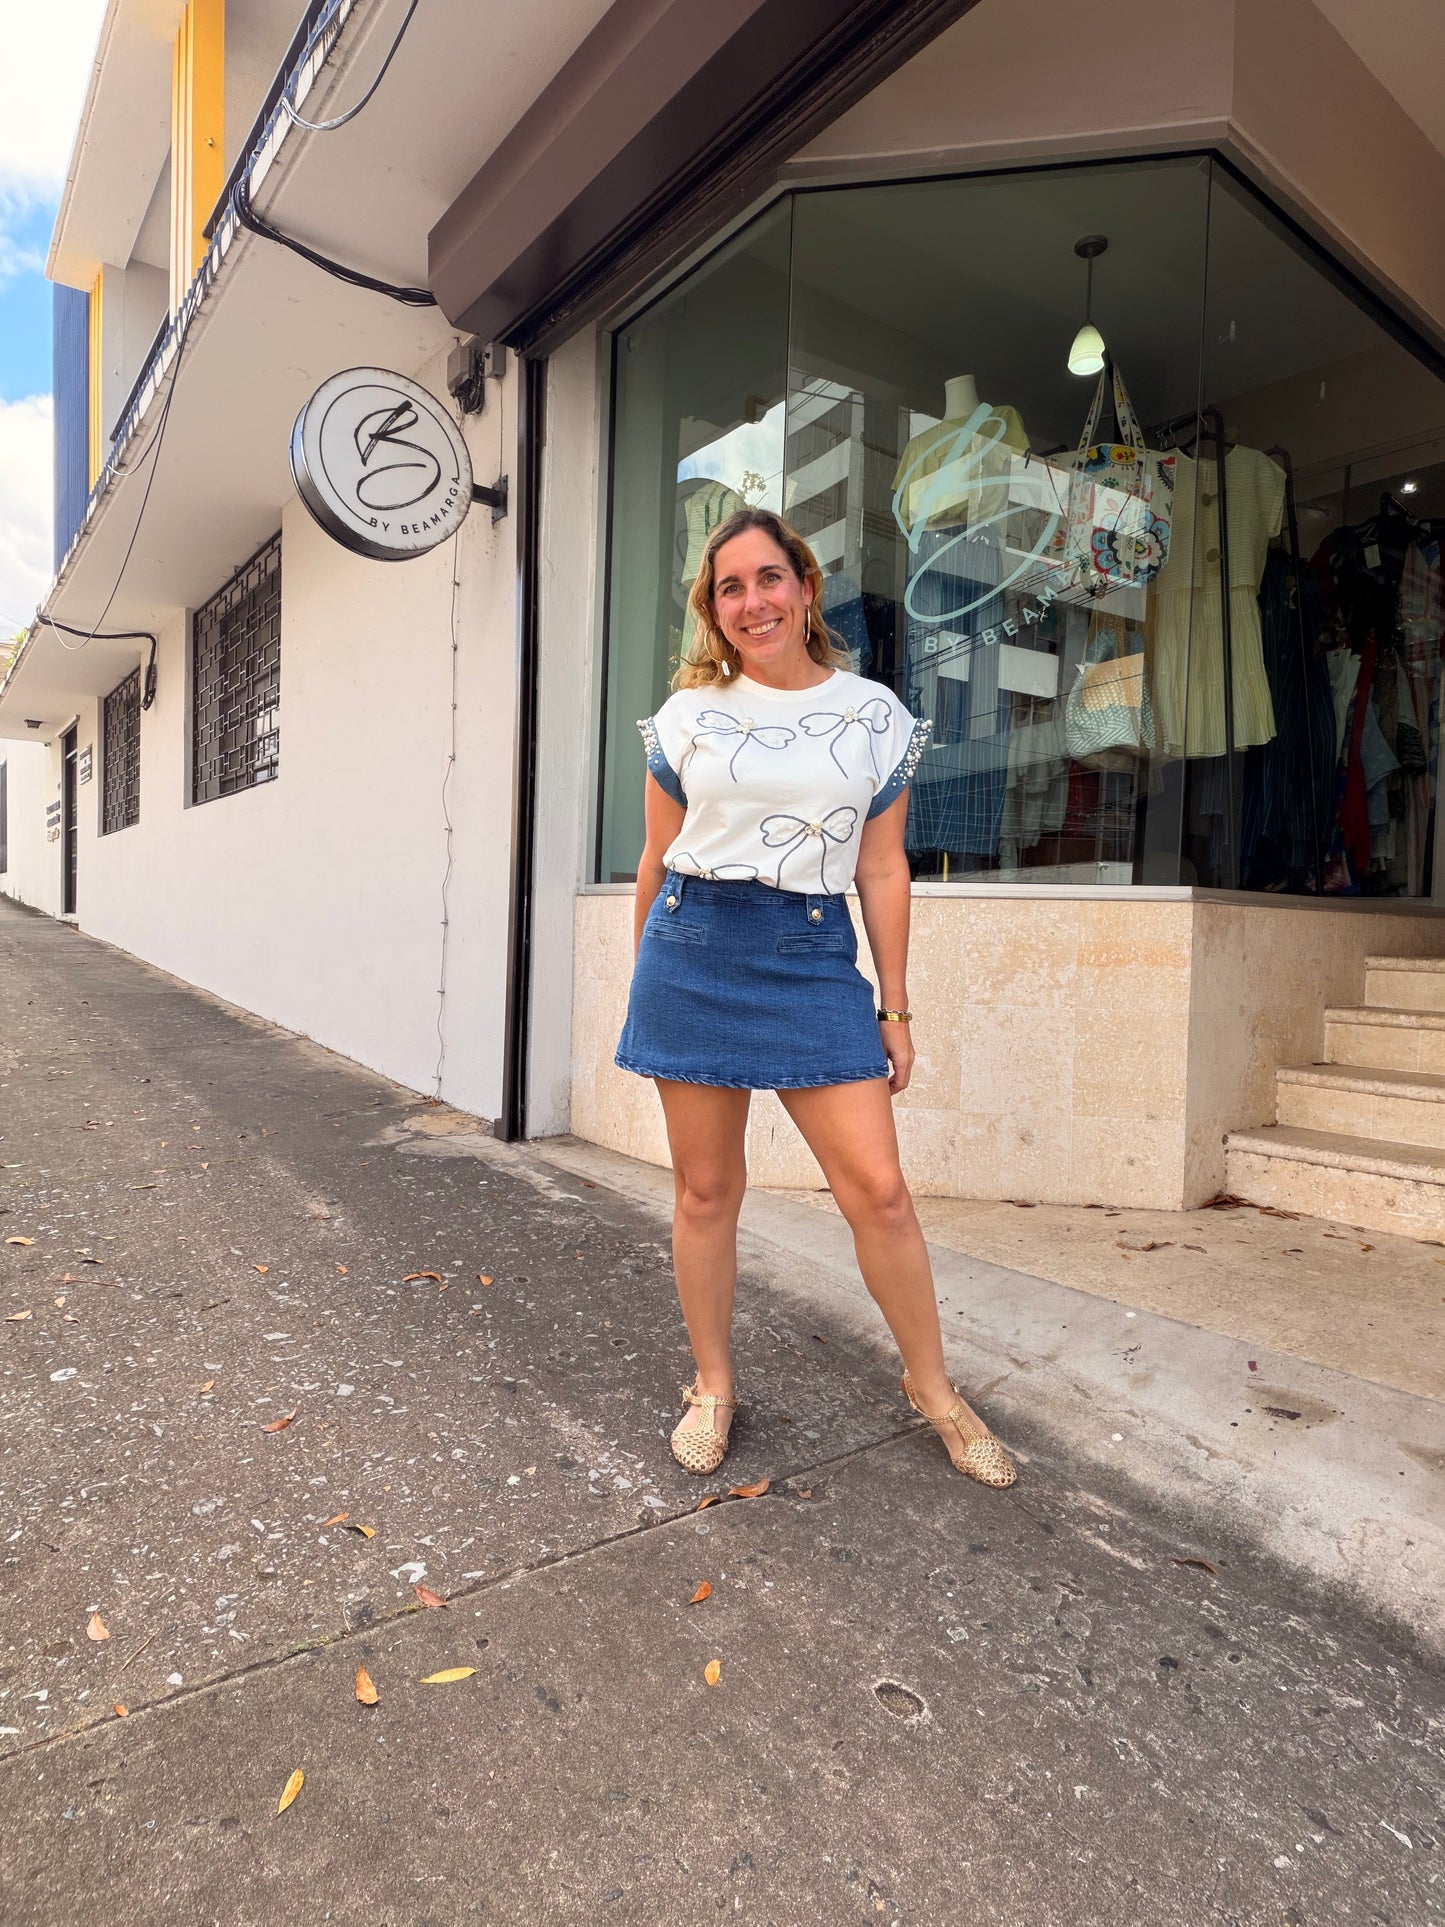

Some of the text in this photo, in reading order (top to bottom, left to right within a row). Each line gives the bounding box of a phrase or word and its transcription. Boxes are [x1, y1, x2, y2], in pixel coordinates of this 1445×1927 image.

[370, 476, 461, 535] BY BEAMARGA
[924, 636, 961, 653] BY
